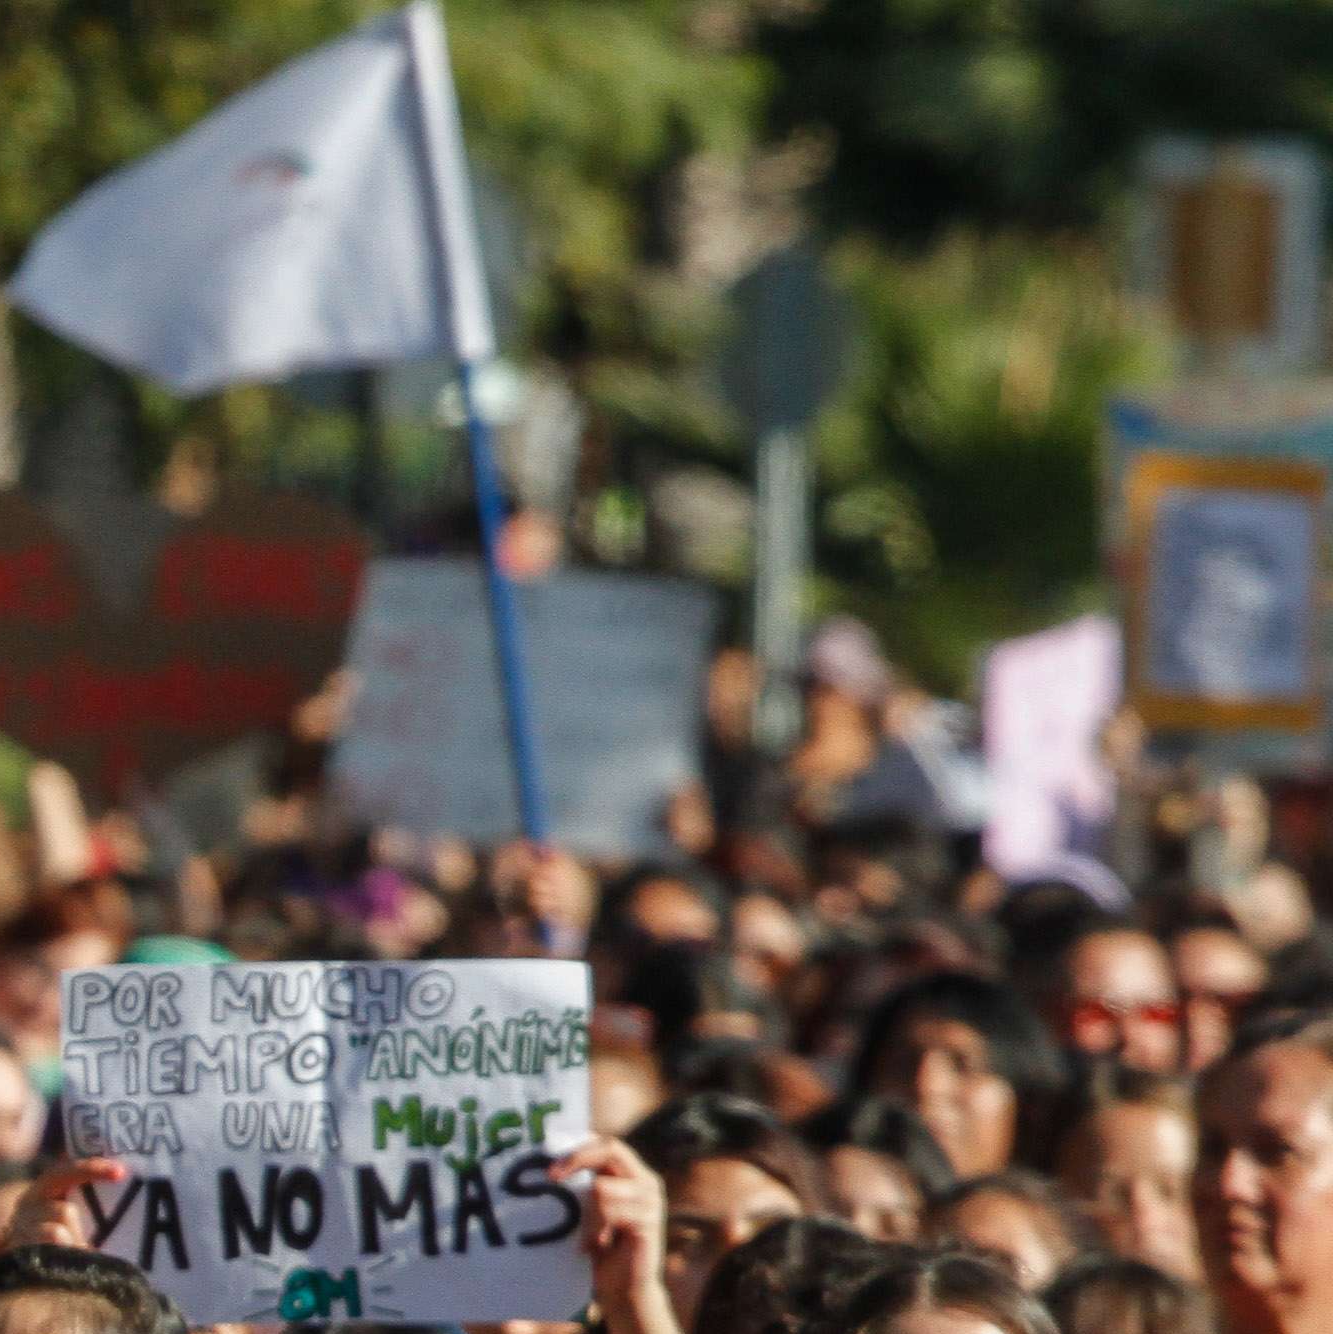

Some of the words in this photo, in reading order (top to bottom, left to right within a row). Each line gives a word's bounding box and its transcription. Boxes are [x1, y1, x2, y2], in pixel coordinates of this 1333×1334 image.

[68, 971, 183, 1034] POR
[211, 966, 455, 1026] MUCHO
[67, 1101, 184, 1158] ERA
[221, 1101, 340, 1154] UNA
[373, 1096, 561, 1172] Mujer
[81, 1176, 191, 1272] YA
[217, 1163, 324, 1260] NO
